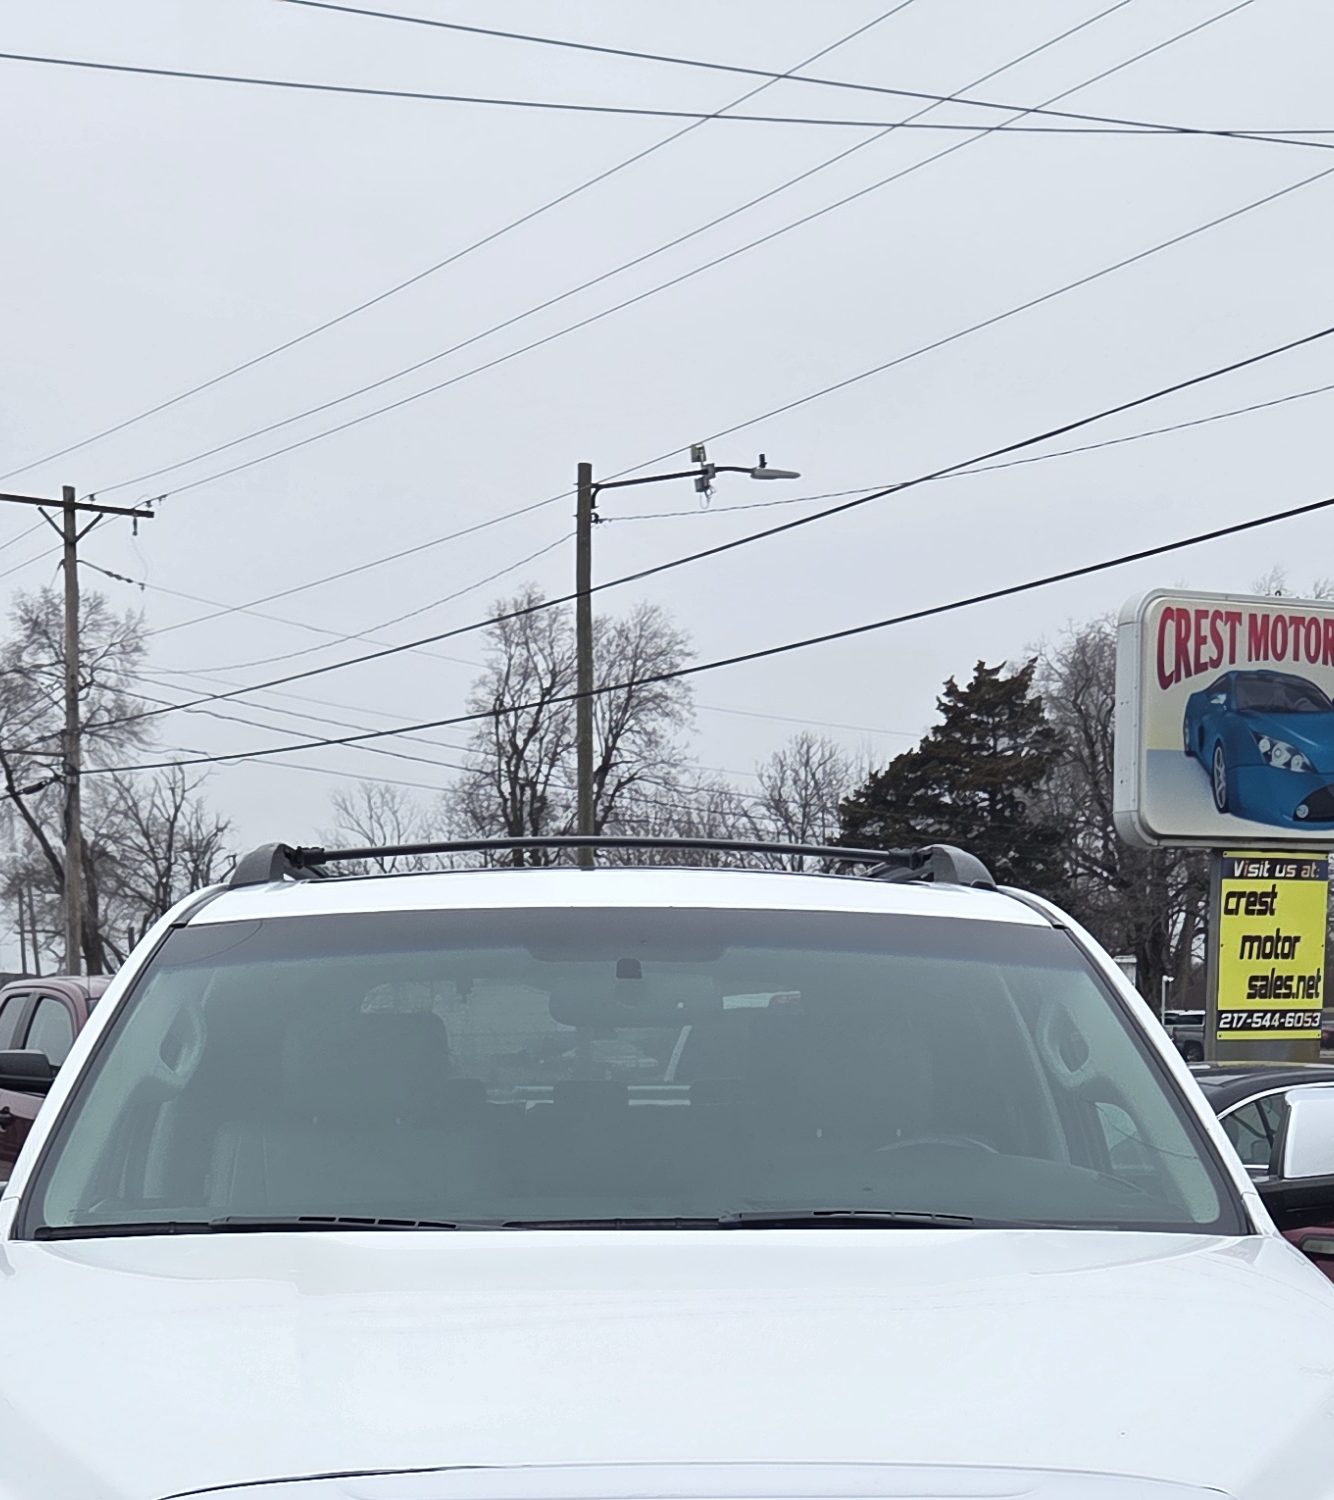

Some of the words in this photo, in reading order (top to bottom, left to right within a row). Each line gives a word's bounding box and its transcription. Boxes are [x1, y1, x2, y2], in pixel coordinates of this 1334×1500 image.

[1156, 606, 1242, 691] CREST
[1233, 860, 1270, 878] Visit
[1275, 864, 1297, 878] us
[1300, 861, 1320, 879] at:
[1223, 884, 1278, 916] crest
[1239, 928, 1301, 960] motor
[1246, 968, 1322, 1000] sales.net
[1219, 1012, 1321, 1029] 217-544-6053
